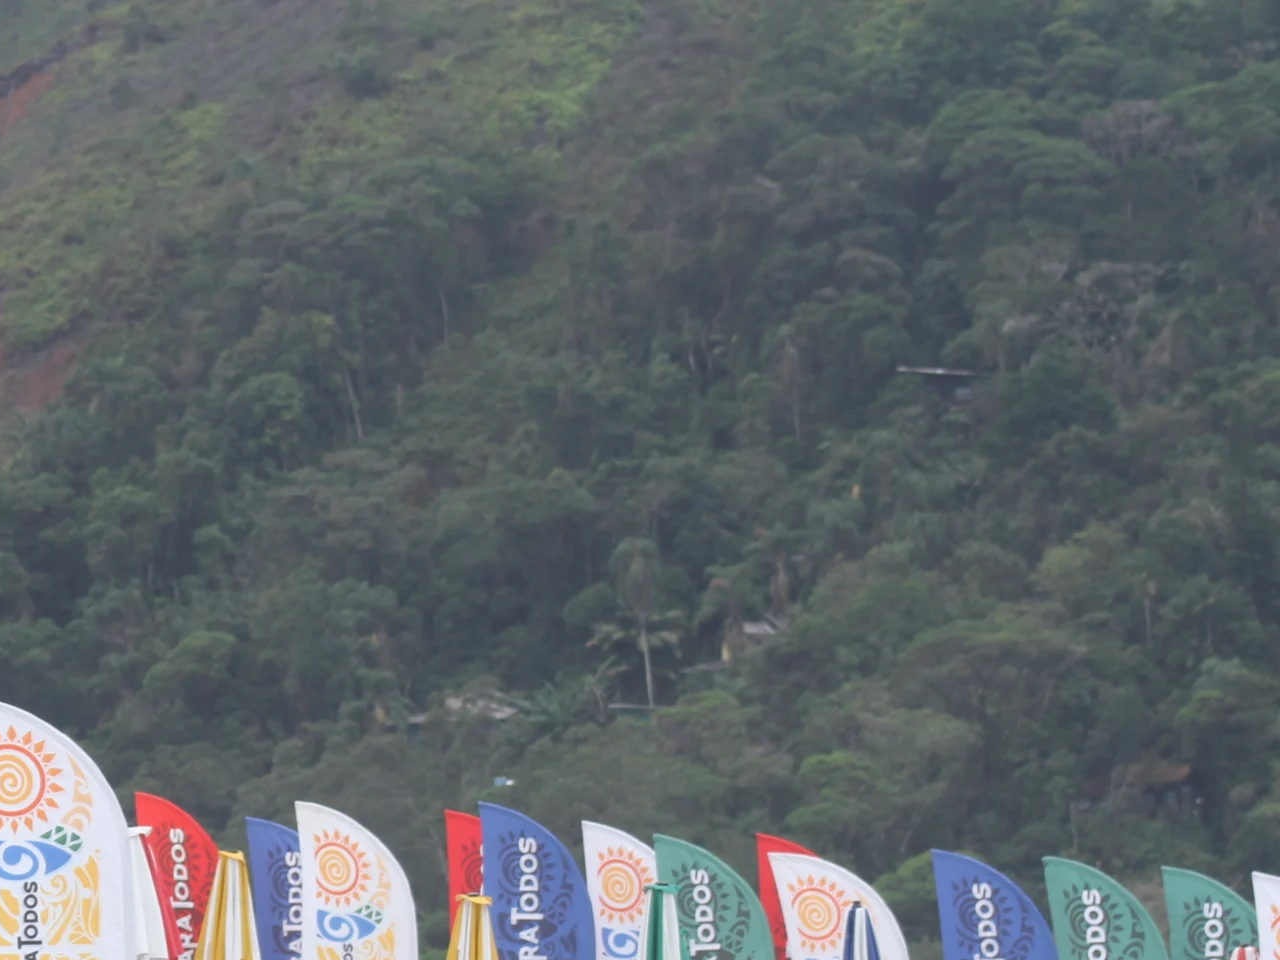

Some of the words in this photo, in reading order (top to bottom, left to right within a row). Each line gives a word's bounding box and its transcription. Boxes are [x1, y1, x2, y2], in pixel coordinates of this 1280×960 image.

[169, 828, 195, 909] TODOS
[510, 836, 544, 926] TODOS
[17, 880, 41, 950] TODOS
[689, 868, 721, 957] TODOS
